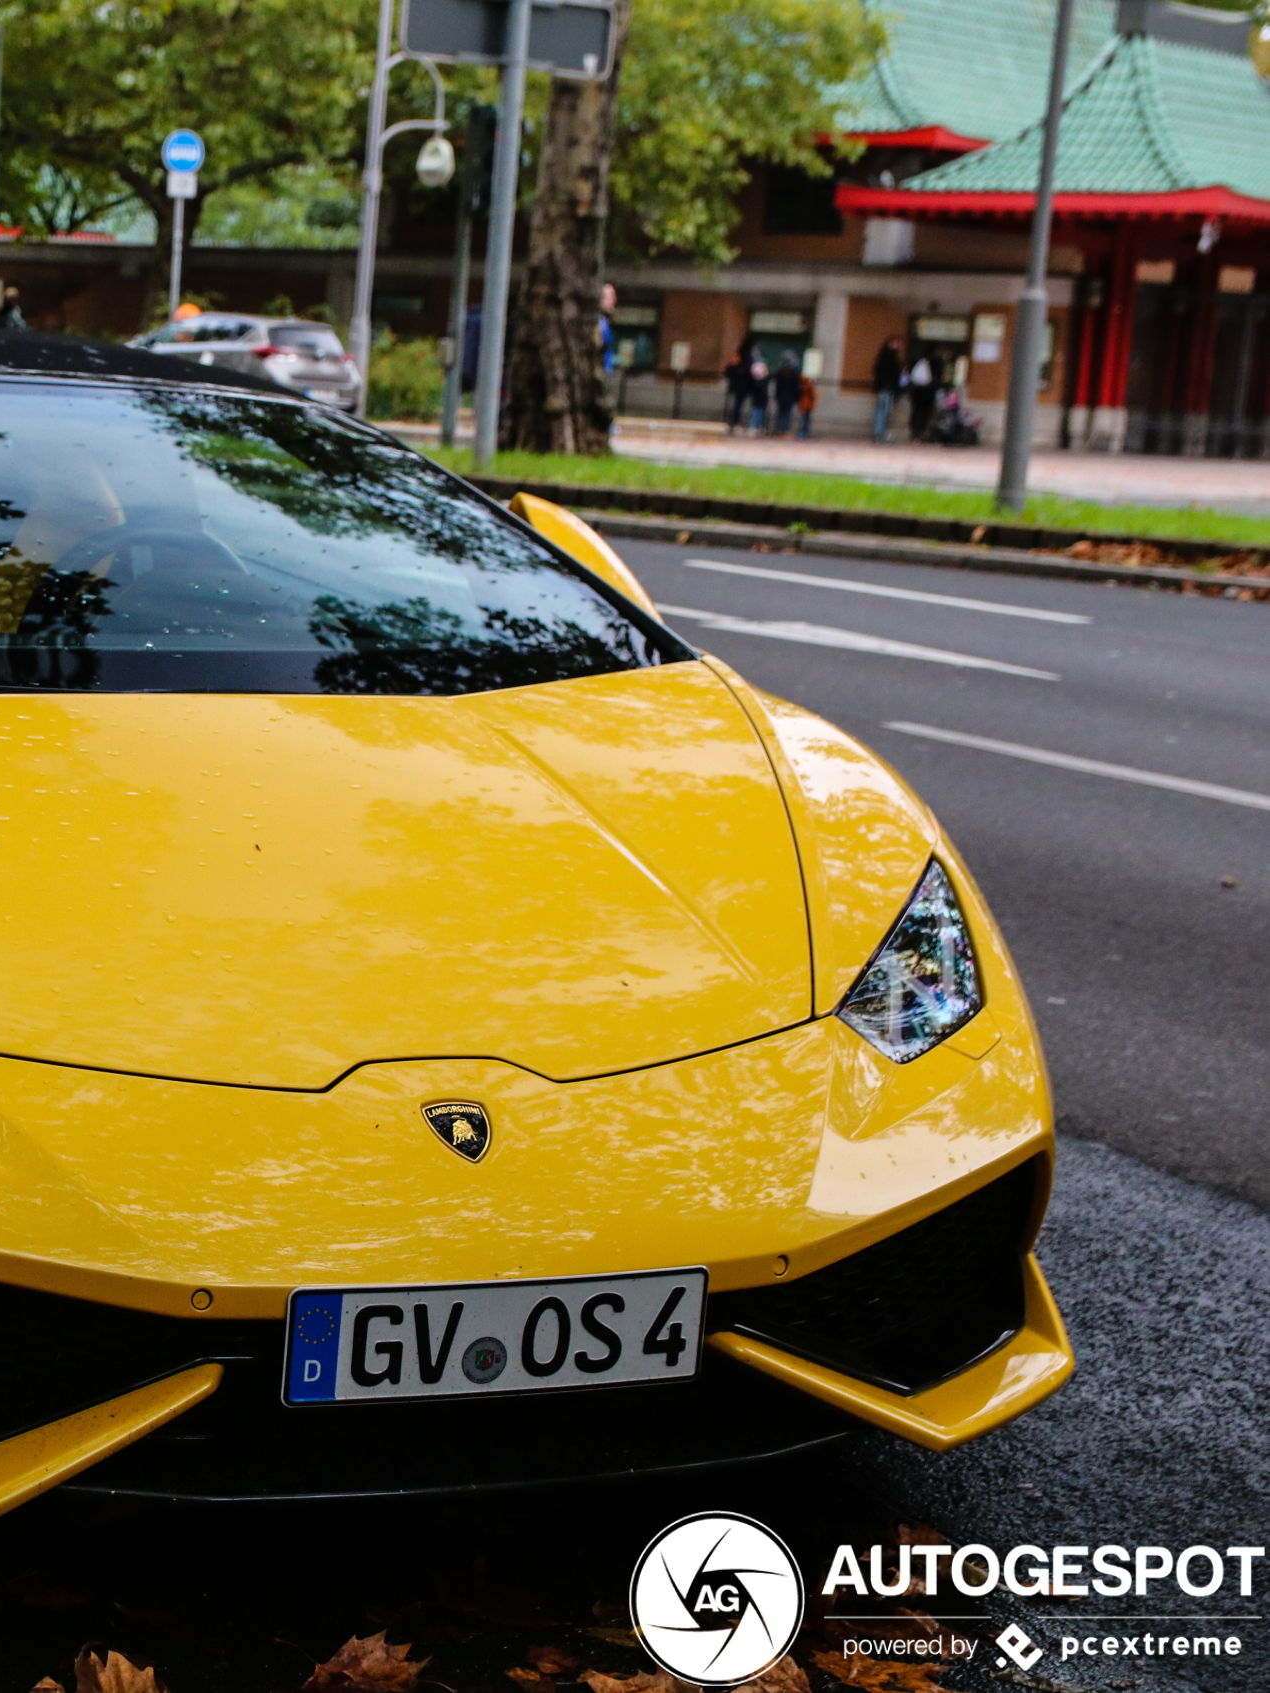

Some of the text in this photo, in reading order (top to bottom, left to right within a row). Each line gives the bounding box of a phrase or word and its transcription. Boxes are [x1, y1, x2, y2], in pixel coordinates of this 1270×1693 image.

[427, 1105, 481, 1118] LAMBORGHINI
[350, 1301, 465, 1387] GV
[521, 1293, 626, 1378] OS
[643, 1286, 687, 1366] 4
[304, 1359, 321, 1382] D
